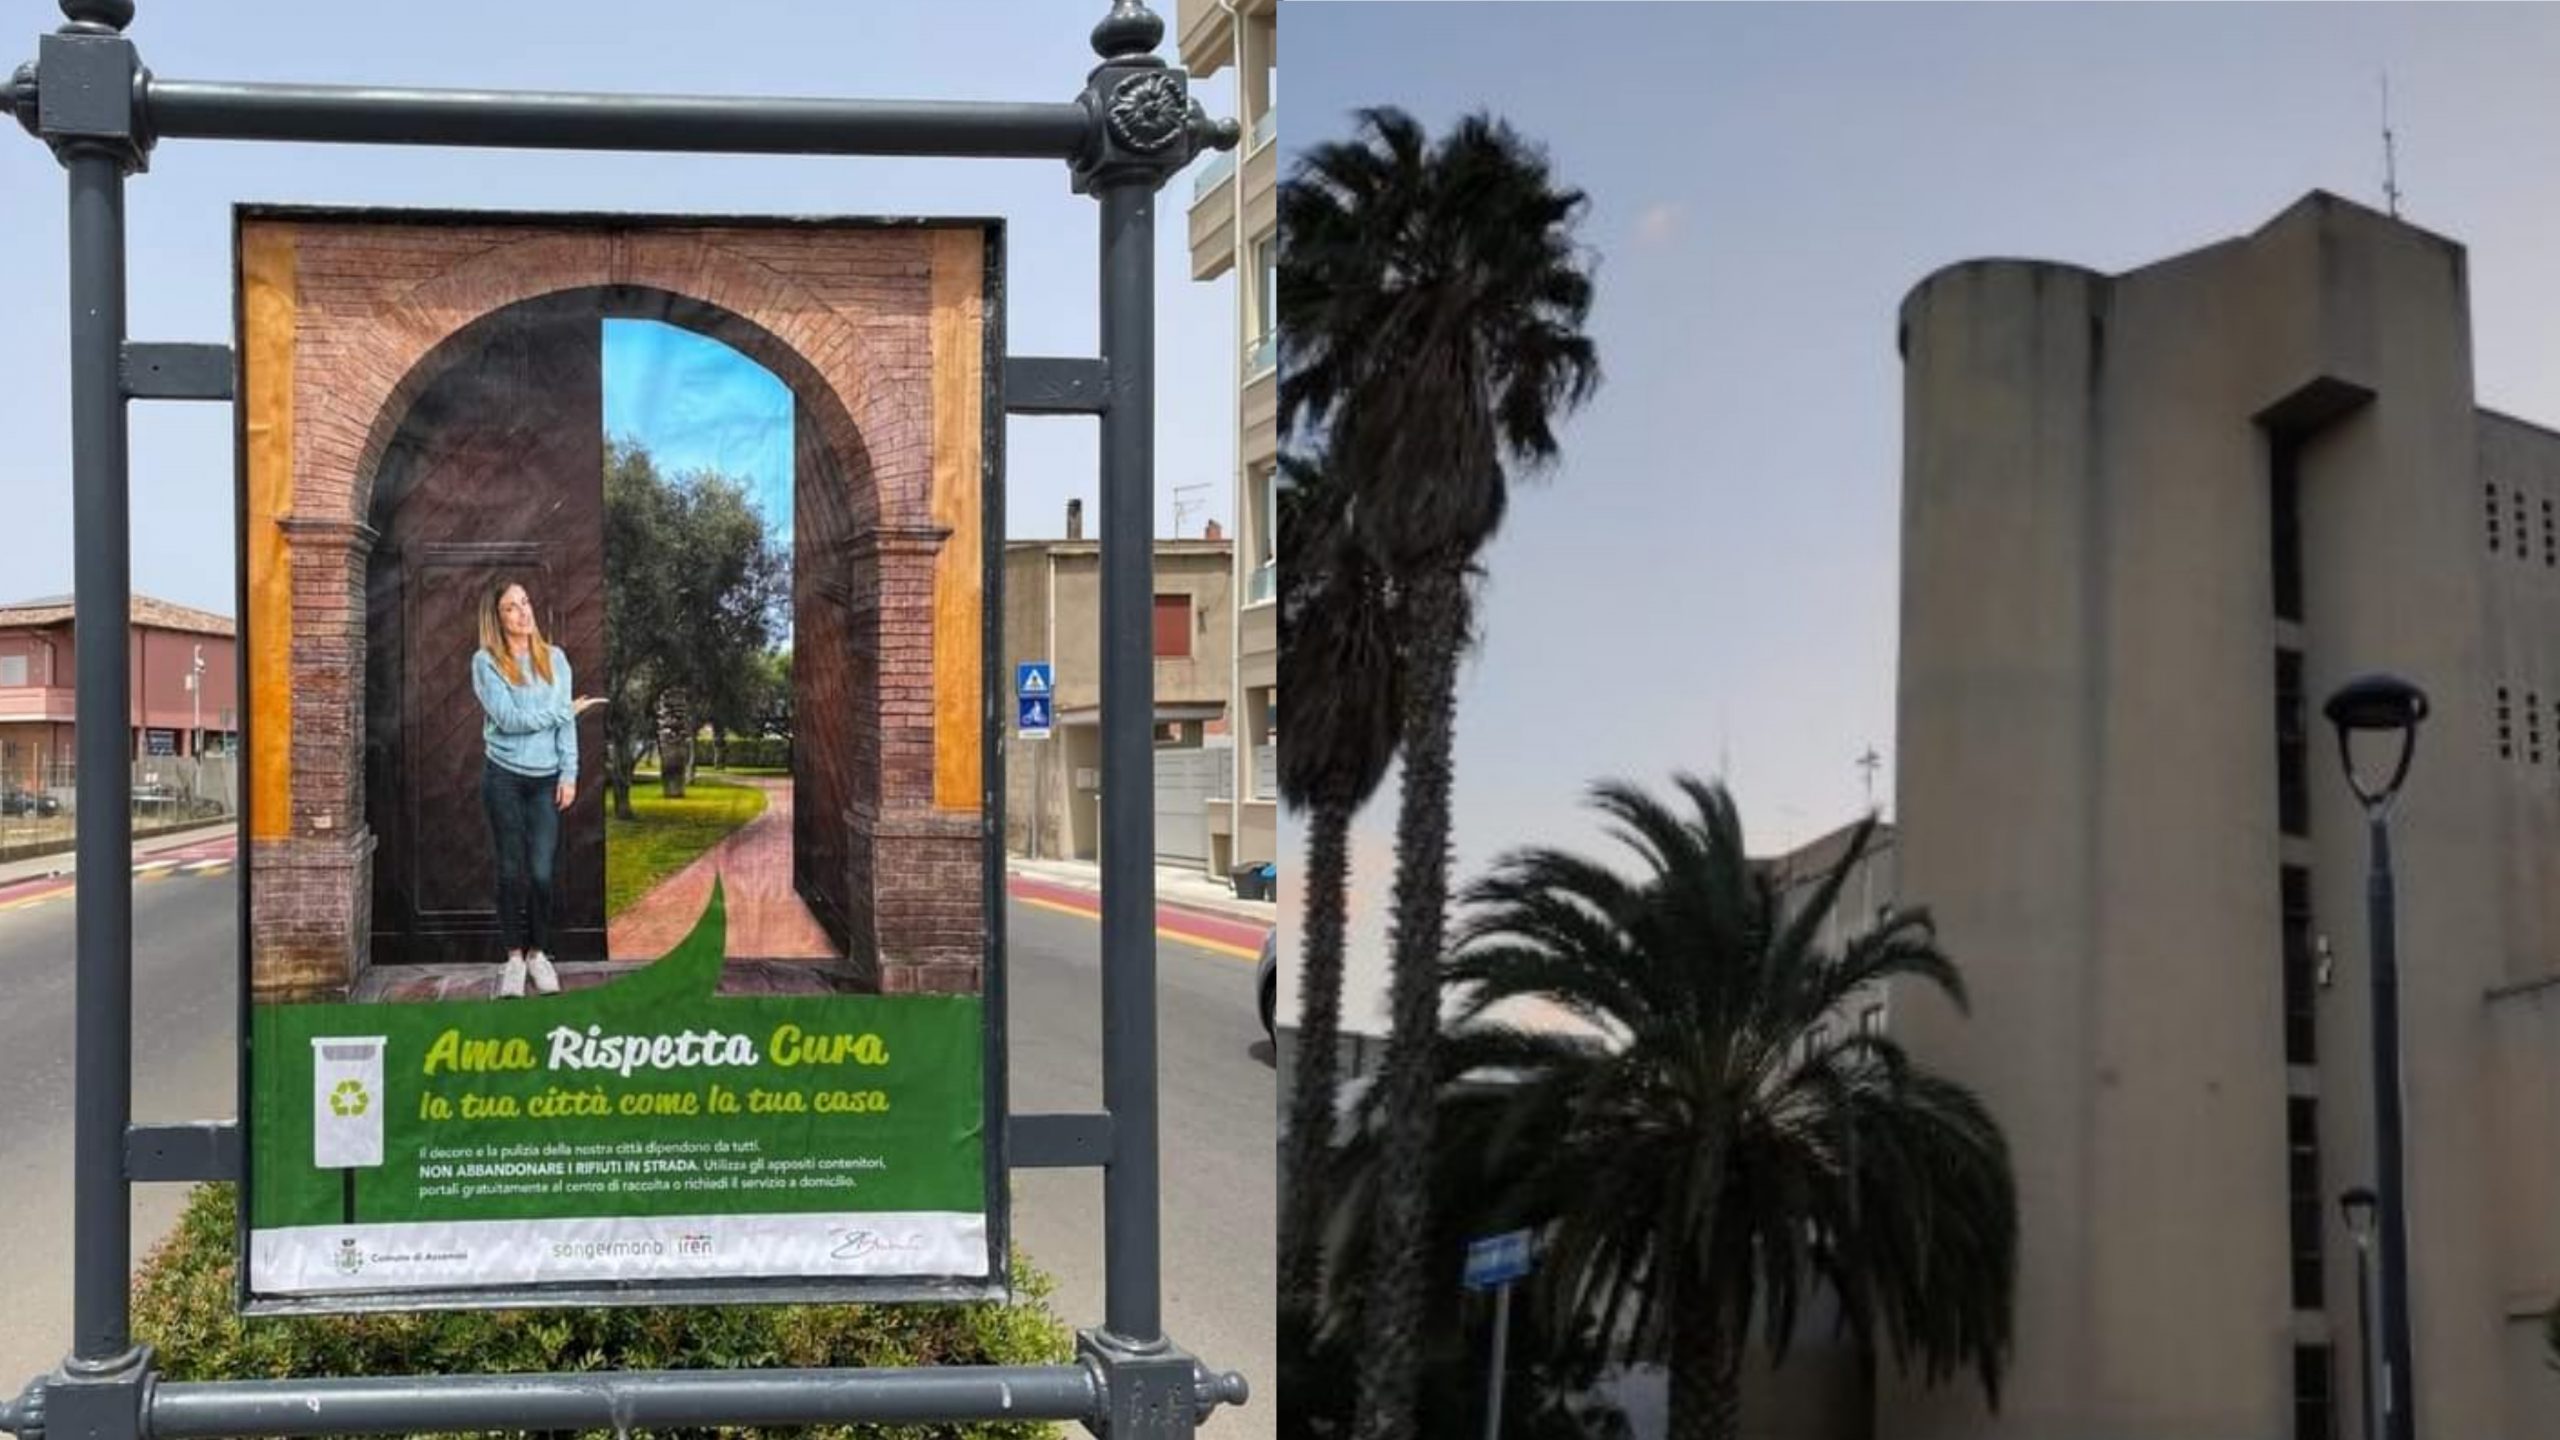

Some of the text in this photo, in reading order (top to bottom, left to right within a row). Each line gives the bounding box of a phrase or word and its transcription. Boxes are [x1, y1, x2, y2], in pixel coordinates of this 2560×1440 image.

[423, 1023, 890, 1078] Ama Rispetta Cura
[420, 1084, 890, 1120] la tua città come la tua casa
[430, 1147, 472, 1159] decoro
[476, 1149, 484, 1157] e
[487, 1144, 497, 1156] la
[501, 1144, 539, 1160] pulizia
[543, 1143, 571, 1156] della
[575, 1143, 613, 1155] nostra
[616, 1141, 643, 1154] città
[645, 1140, 711, 1156] dipendono
[714, 1140, 729, 1152] da
[732, 1139, 761, 1152] tutti.
[420, 1155, 886, 1178] NON ABBANDONARE I RIFIUTI IN STRADA. Utilizza gli appositi contenitori,
[420, 1182, 459, 1199] portali
[462, 1182, 548, 1198] gratuitamente
[552, 1179, 562, 1194] al
[566, 1180, 604, 1193] centro
[607, 1179, 619, 1192] di
[623, 1178, 670, 1192] raccolta
[673, 1180, 681, 1190] o
[685, 1177, 728, 1190] richiedi
[741, 1176, 786, 1188] servizio
[790, 1179, 796, 1188] a
[800, 1174, 857, 1188] domicilio.
